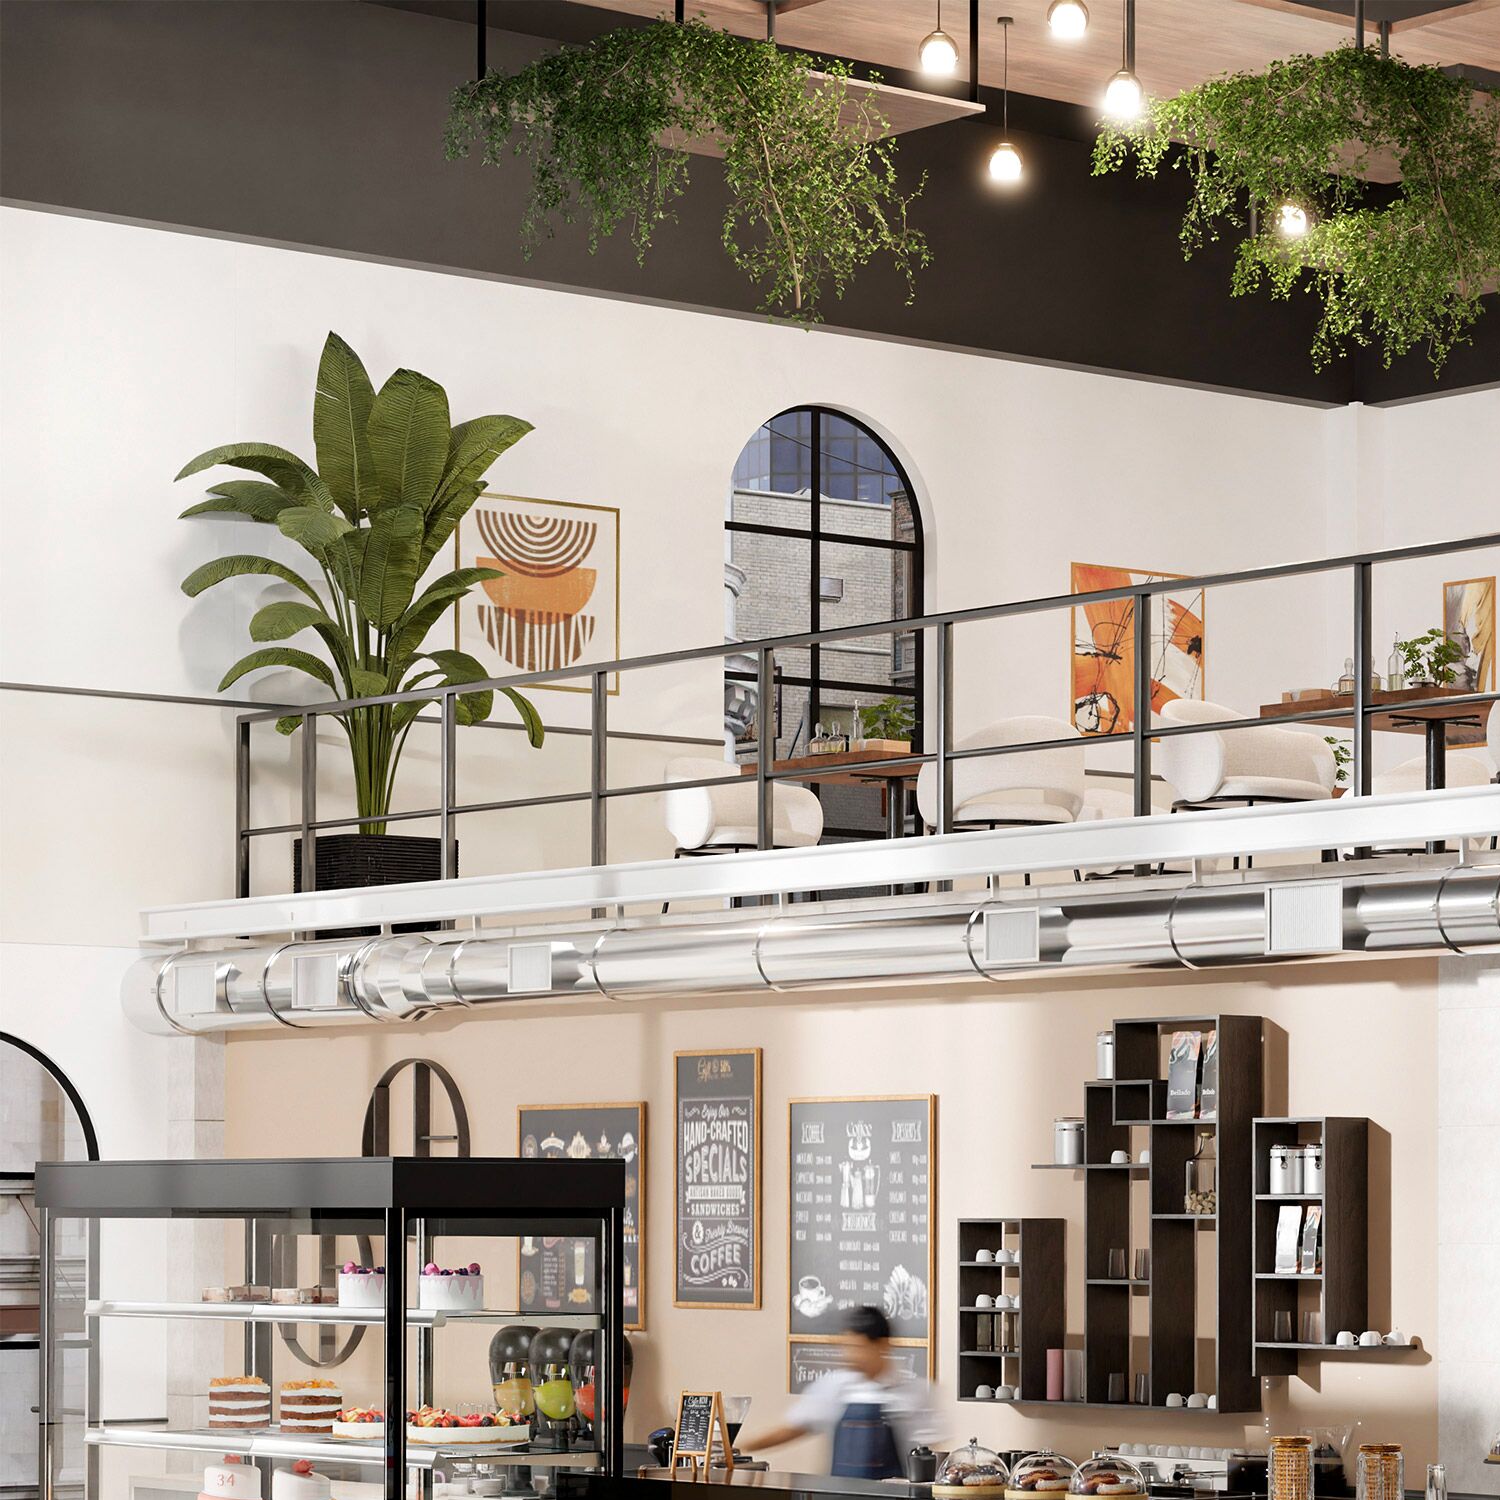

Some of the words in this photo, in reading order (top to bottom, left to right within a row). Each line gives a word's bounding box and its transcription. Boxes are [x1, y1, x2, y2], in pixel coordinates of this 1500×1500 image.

[701, 1104, 718, 1120] Enjoy
[718, 1104, 730, 1118] Our
[684, 1120, 748, 1156] HAND-CRAFTED
[685, 1143, 747, 1184] SPECIALS
[691, 1203, 740, 1216] SANDWICHES
[690, 1243, 742, 1275] COFFEE
[217, 1473, 235, 1487] 34
